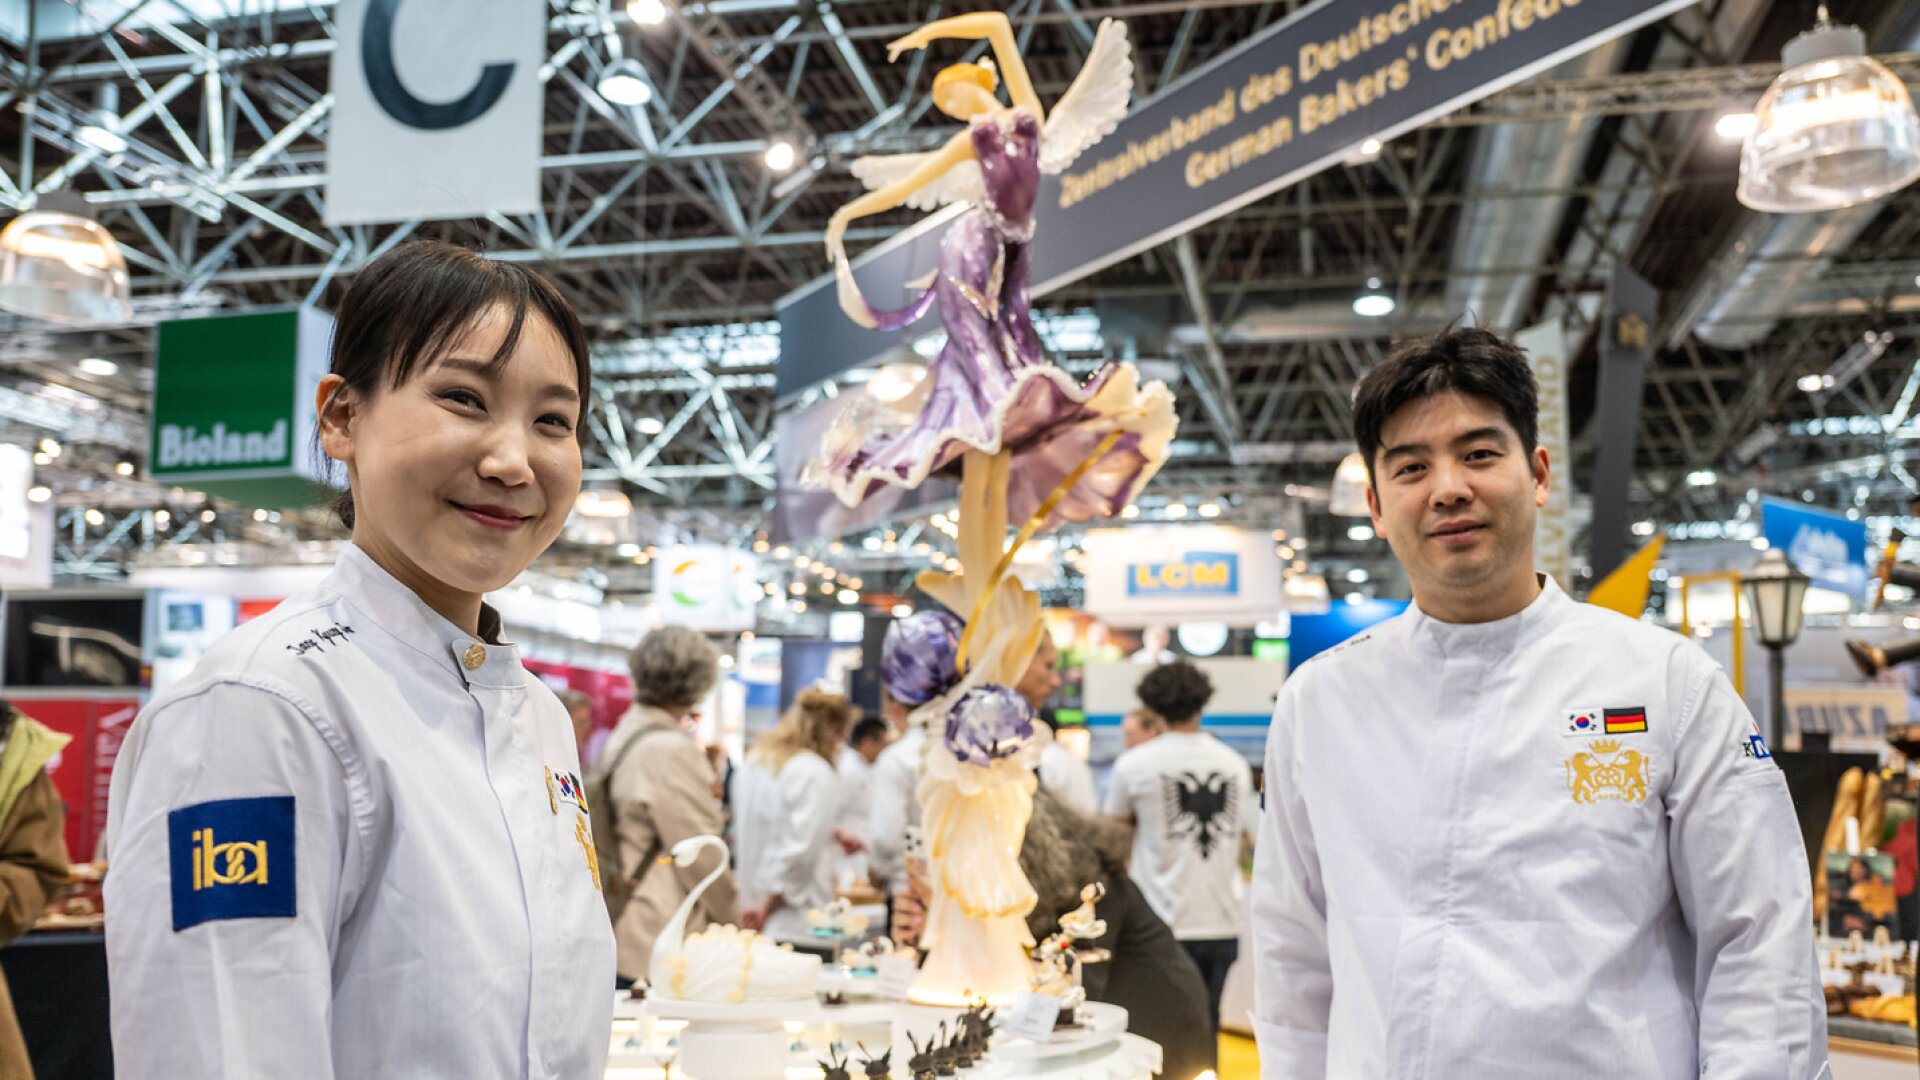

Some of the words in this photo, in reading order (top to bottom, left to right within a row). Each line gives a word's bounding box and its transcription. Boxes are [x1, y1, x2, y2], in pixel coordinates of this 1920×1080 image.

[1059, 87, 1237, 209] Zentralverband
[1240, 65, 1293, 113] des
[1299, 0, 1455, 82] Deutsch
[1185, 117, 1293, 188] German
[1425, 0, 1581, 72] Confed
[158, 418, 288, 468] Bioland
[1137, 562, 1229, 588] LCM
[192, 827, 268, 891] iba
